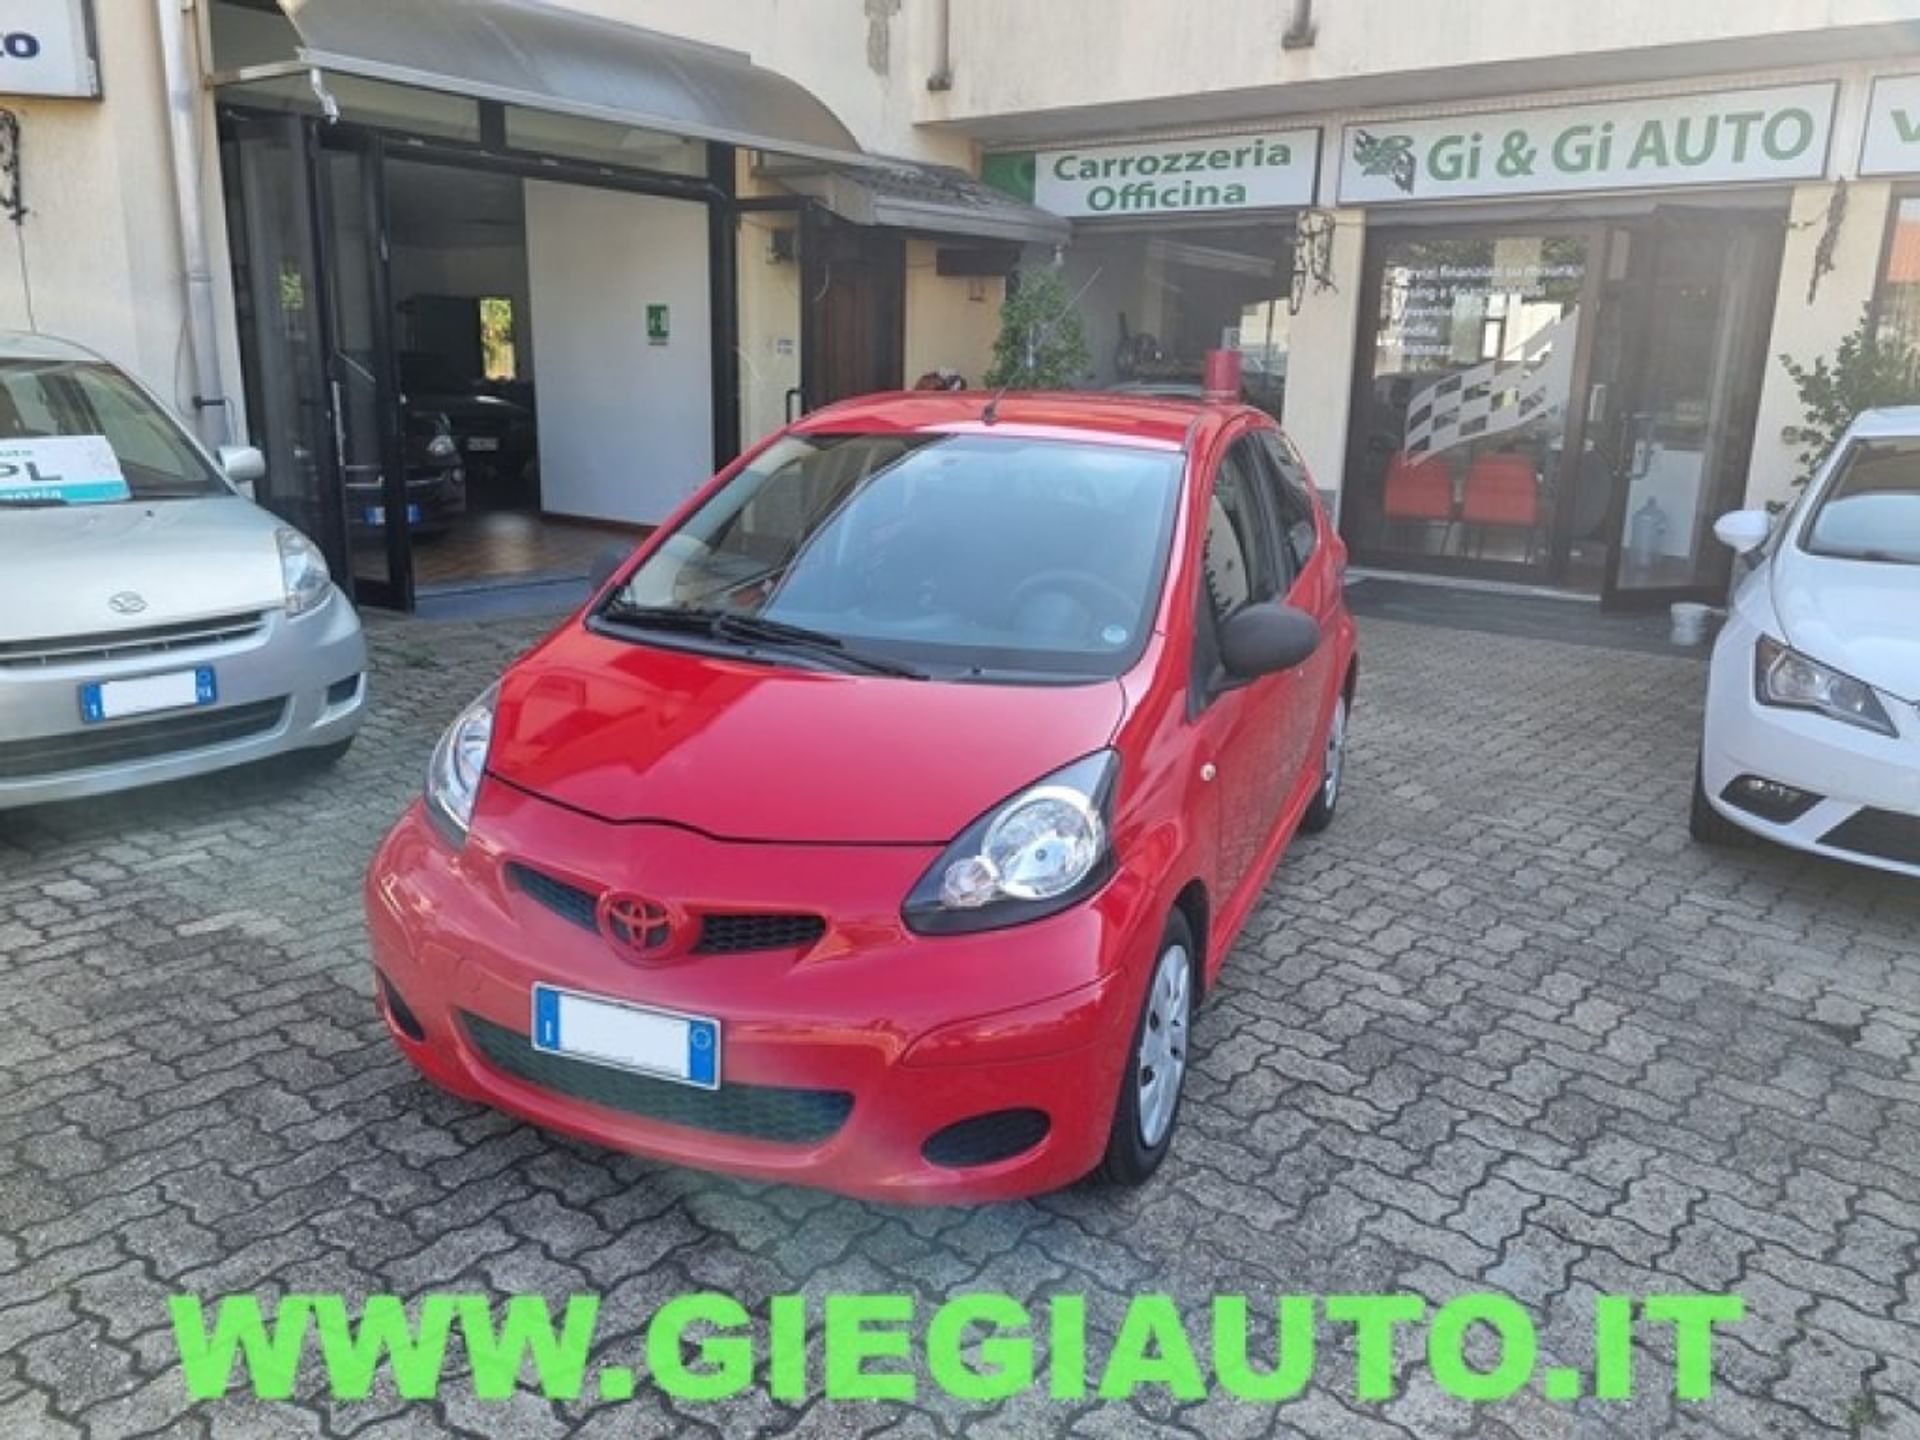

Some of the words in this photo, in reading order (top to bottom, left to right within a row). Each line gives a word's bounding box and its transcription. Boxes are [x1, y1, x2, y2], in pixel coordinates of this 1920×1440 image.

[1053, 138, 1293, 181] Carrozzeria
[1427, 131, 1483, 181] Gi
[1496, 129, 1537, 177] &
[1553, 120, 1615, 172] Gi
[1626, 107, 1814, 170] AUTO
[1086, 179, 1247, 211] Officina
